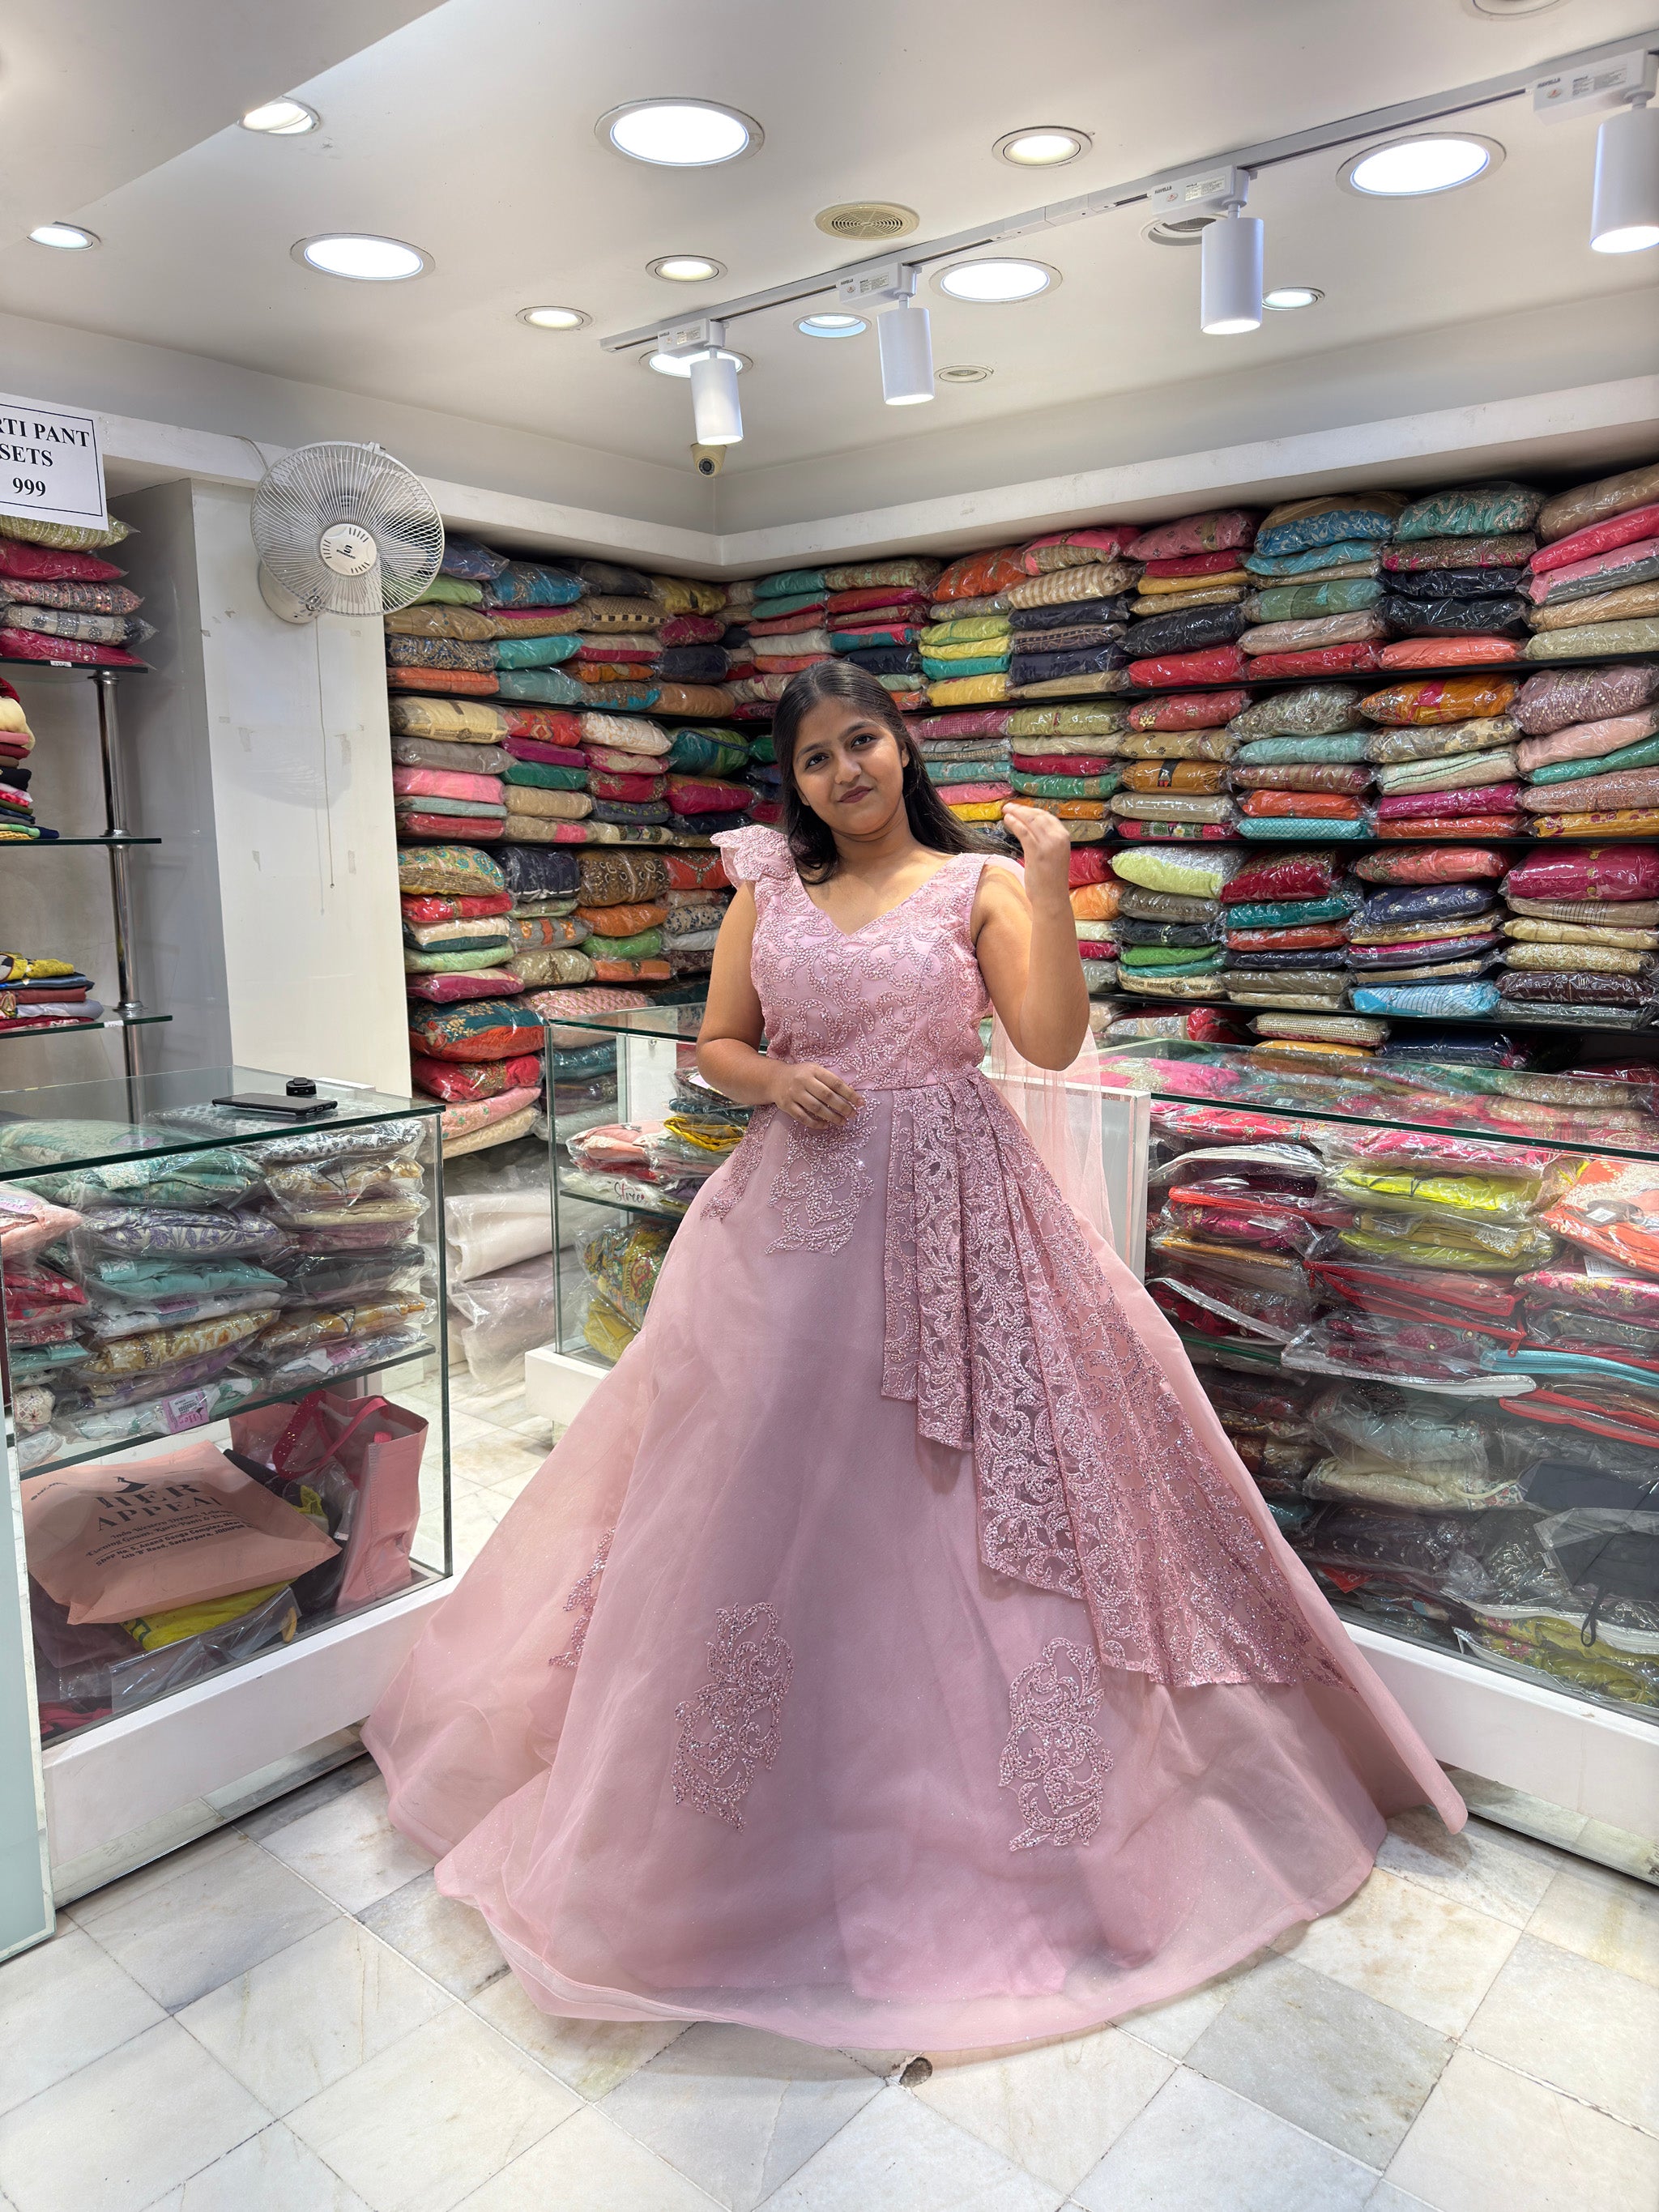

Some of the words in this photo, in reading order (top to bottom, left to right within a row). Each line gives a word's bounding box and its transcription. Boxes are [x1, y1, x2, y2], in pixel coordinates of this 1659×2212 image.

[34, 422, 89, 447] PANT
[0, 443, 53, 467] SETS
[12, 477, 46, 497] 999
[95, 1484, 201, 1509] HER
[96, 1553, 116, 1566] Shop
